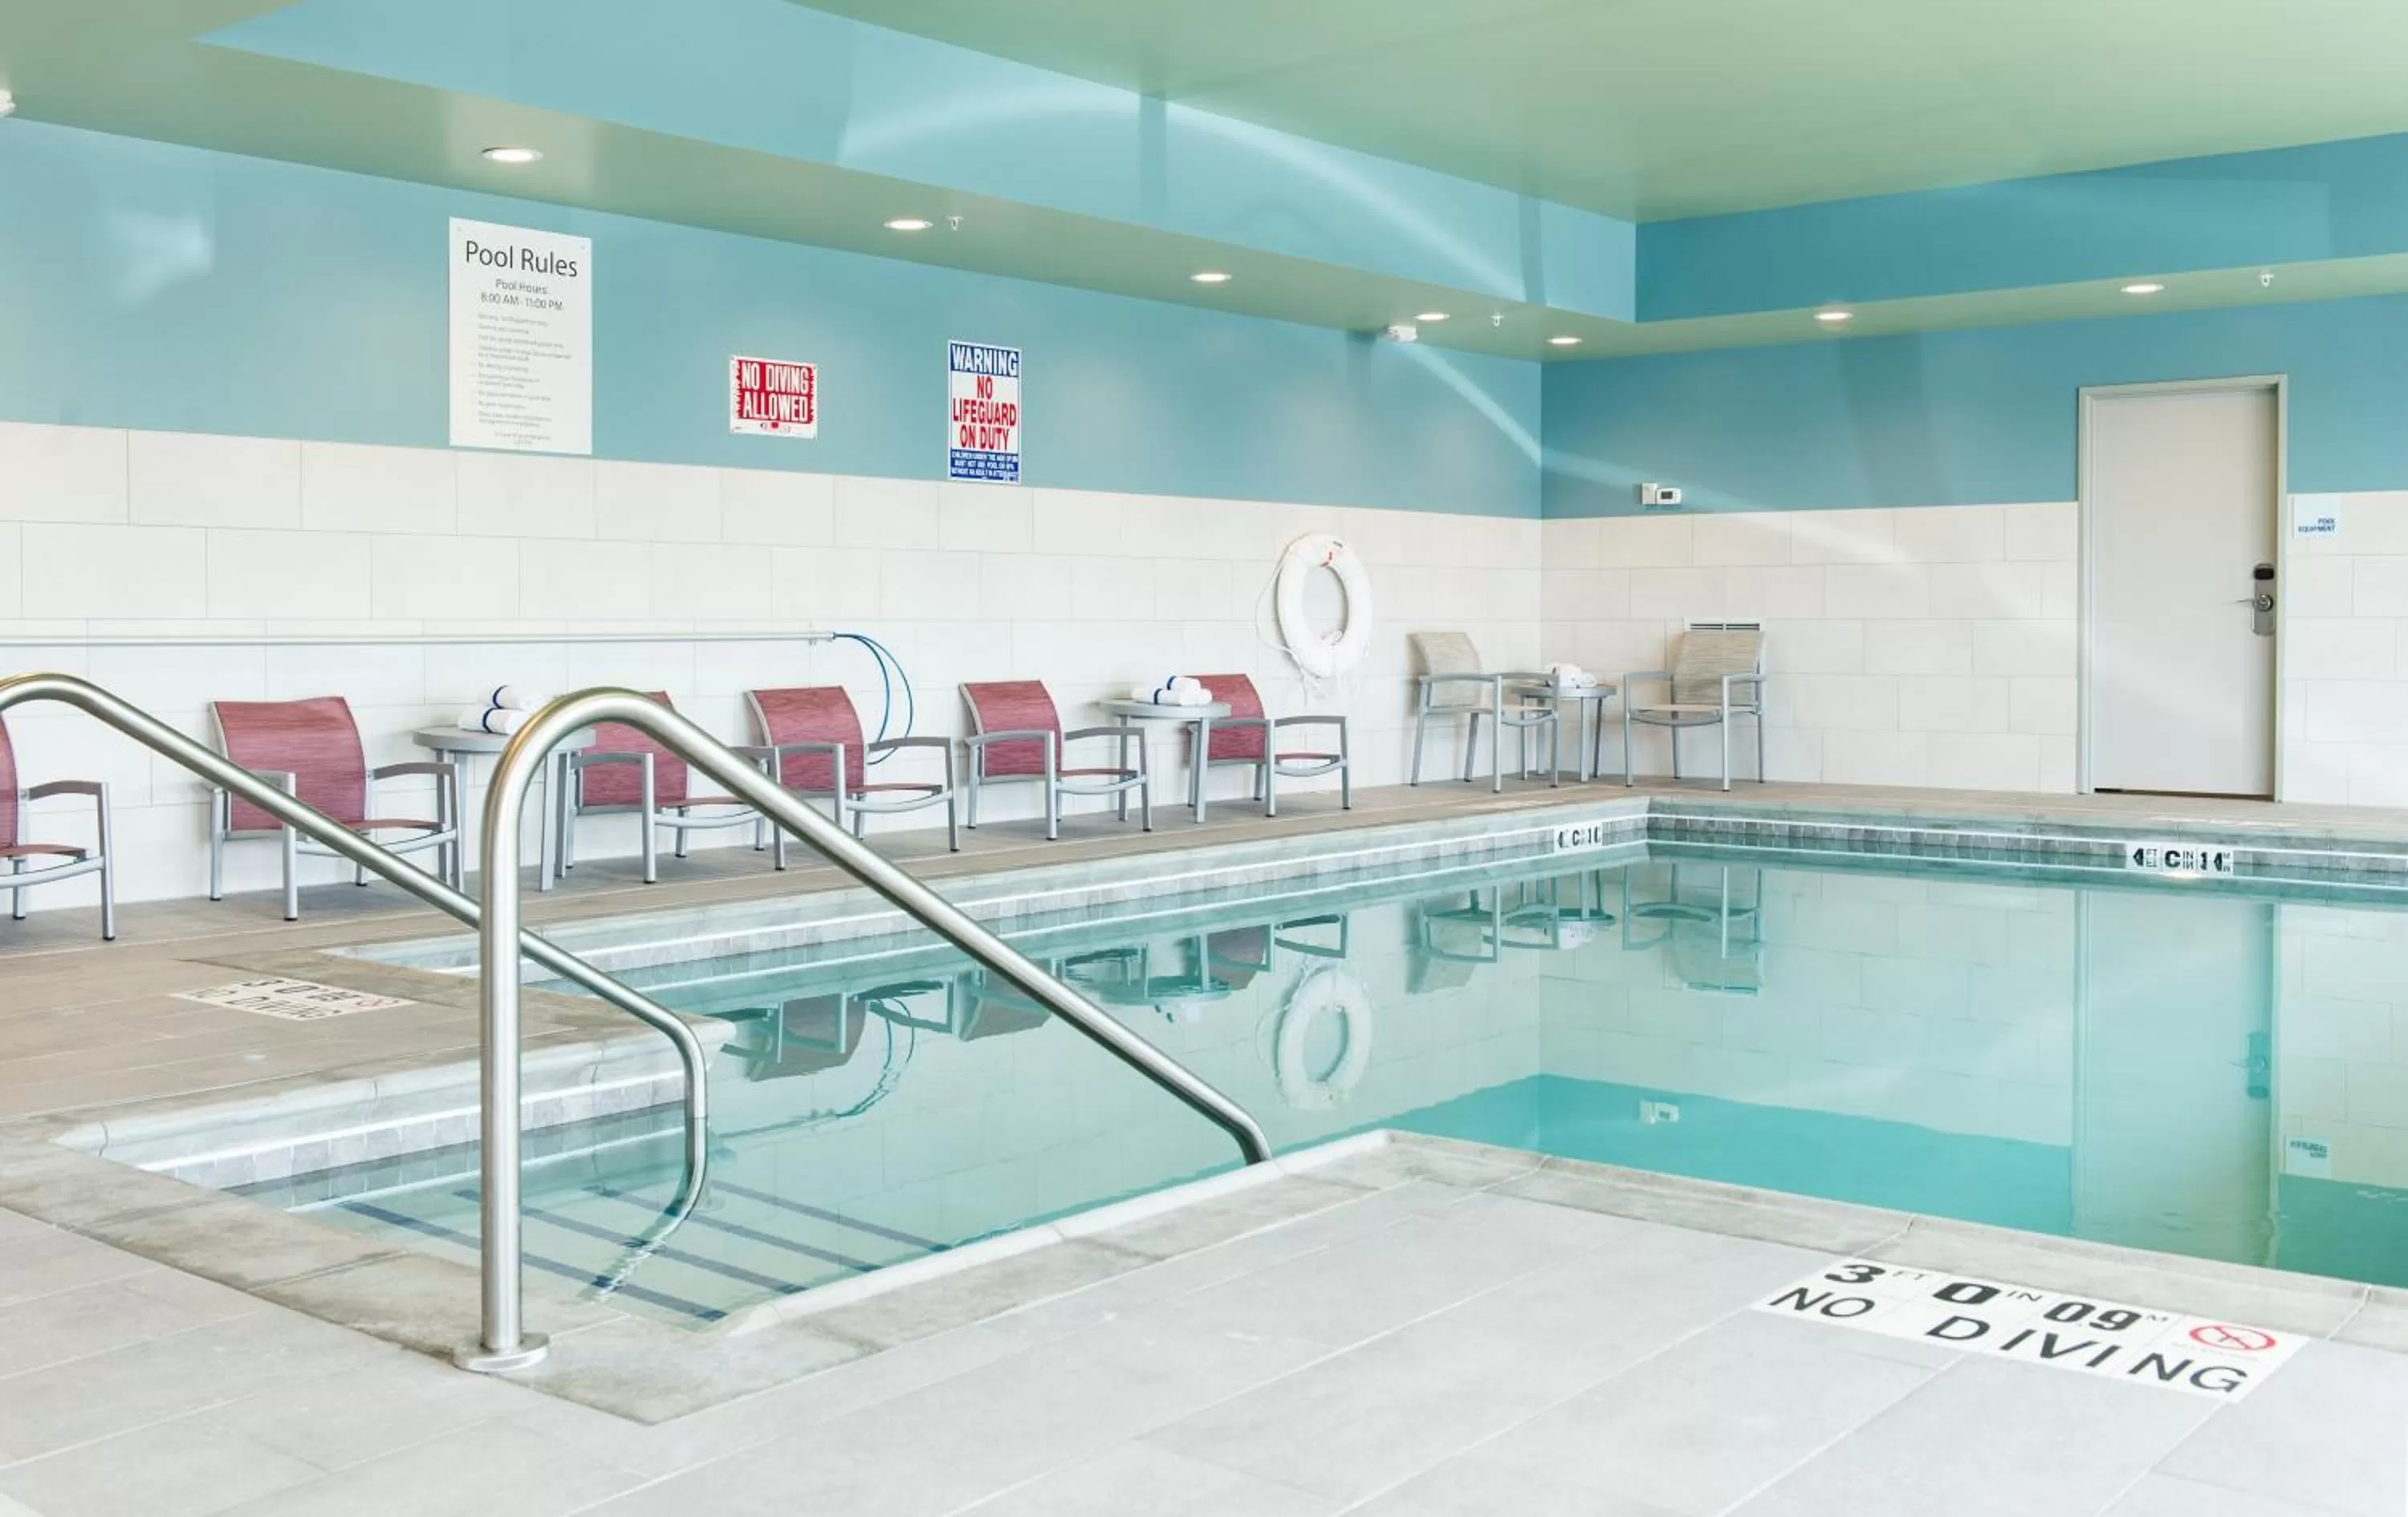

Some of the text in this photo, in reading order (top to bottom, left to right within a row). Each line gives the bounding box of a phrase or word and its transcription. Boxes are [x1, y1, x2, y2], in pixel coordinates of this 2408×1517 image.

[466, 240, 578, 278] Pool Rules
[480, 291, 501, 305] 8:00
[494, 279, 517, 291] Pool
[951, 344, 1018, 376] WARNING
[741, 362, 809, 394] NO DIVING
[977, 375, 993, 400] NO
[742, 391, 808, 421] ALLOWED
[953, 397, 1017, 427] LIFEGUARD
[959, 424, 1010, 451] ON DUTY
[1824, 1264, 1886, 1283] 3
[1932, 1283, 2001, 1305] 0
[2007, 1289, 2043, 1302] IN
[1767, 1287, 2248, 1393] NO DIVING
